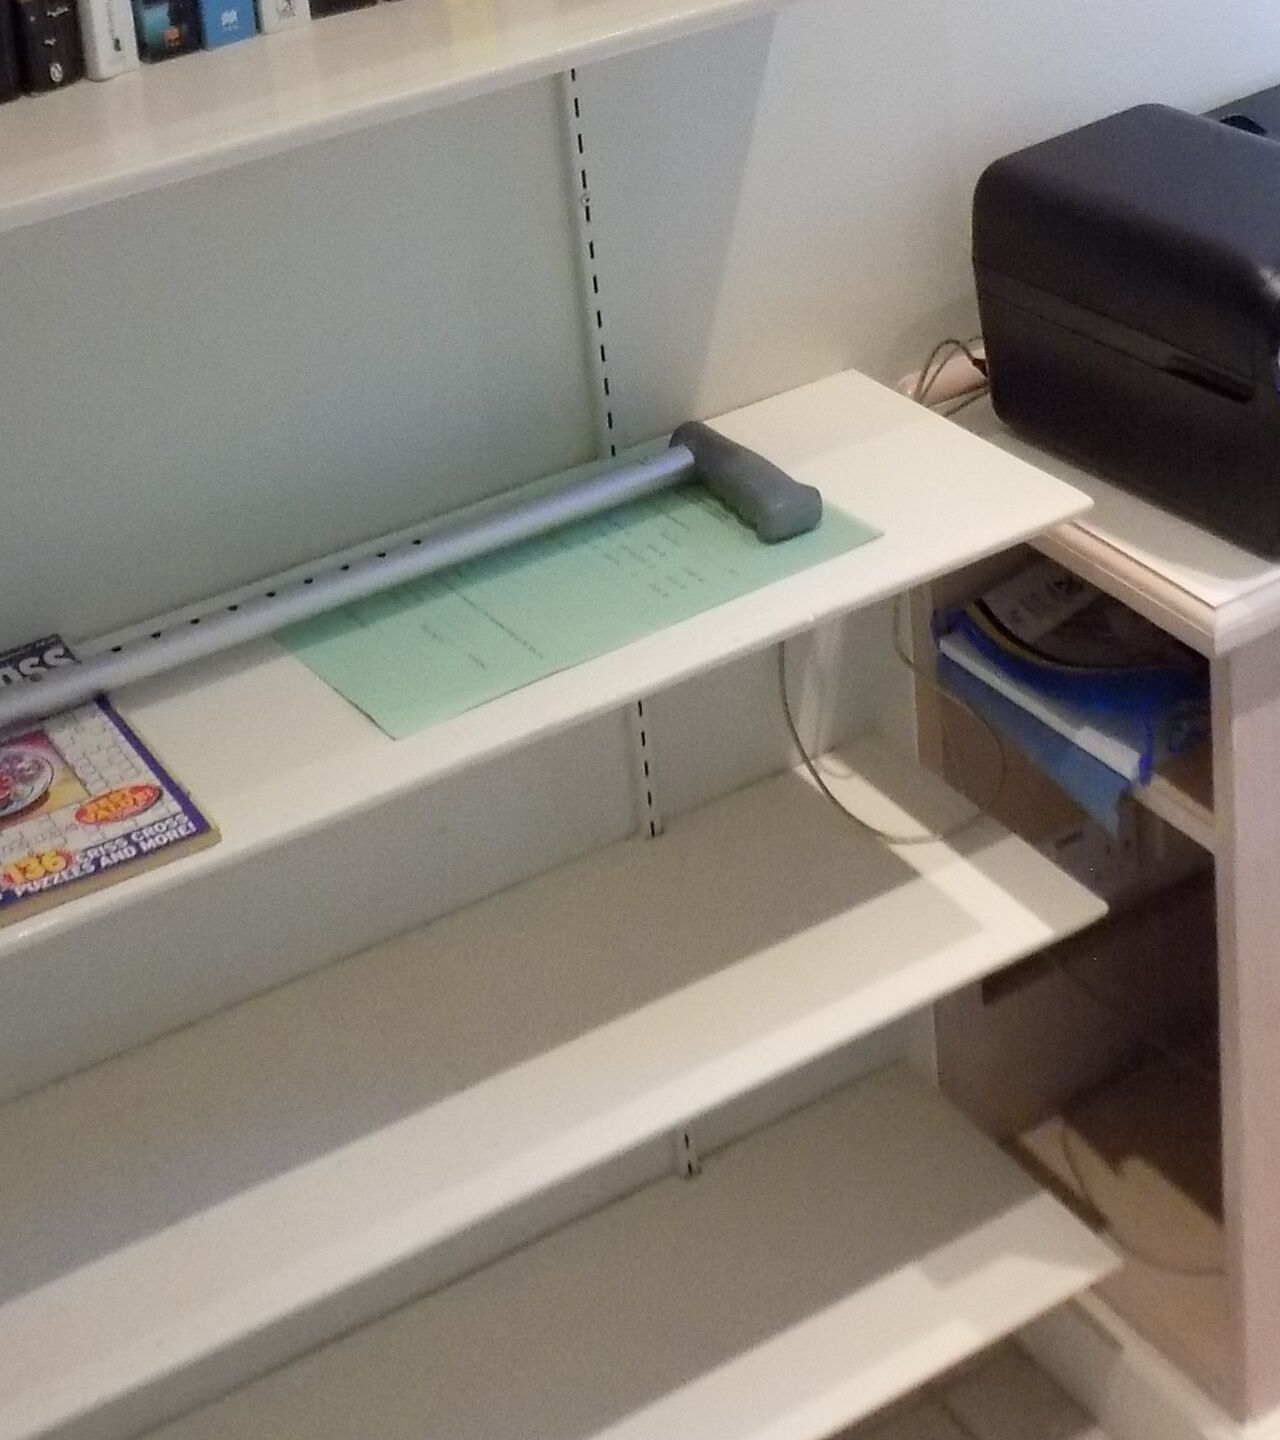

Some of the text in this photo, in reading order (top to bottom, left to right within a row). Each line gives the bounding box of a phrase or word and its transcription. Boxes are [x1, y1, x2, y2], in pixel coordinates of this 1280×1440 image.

[15, 821, 199, 898] PUZZLES AND MORE!
[76, 812, 190, 863] CRISS CROSS
